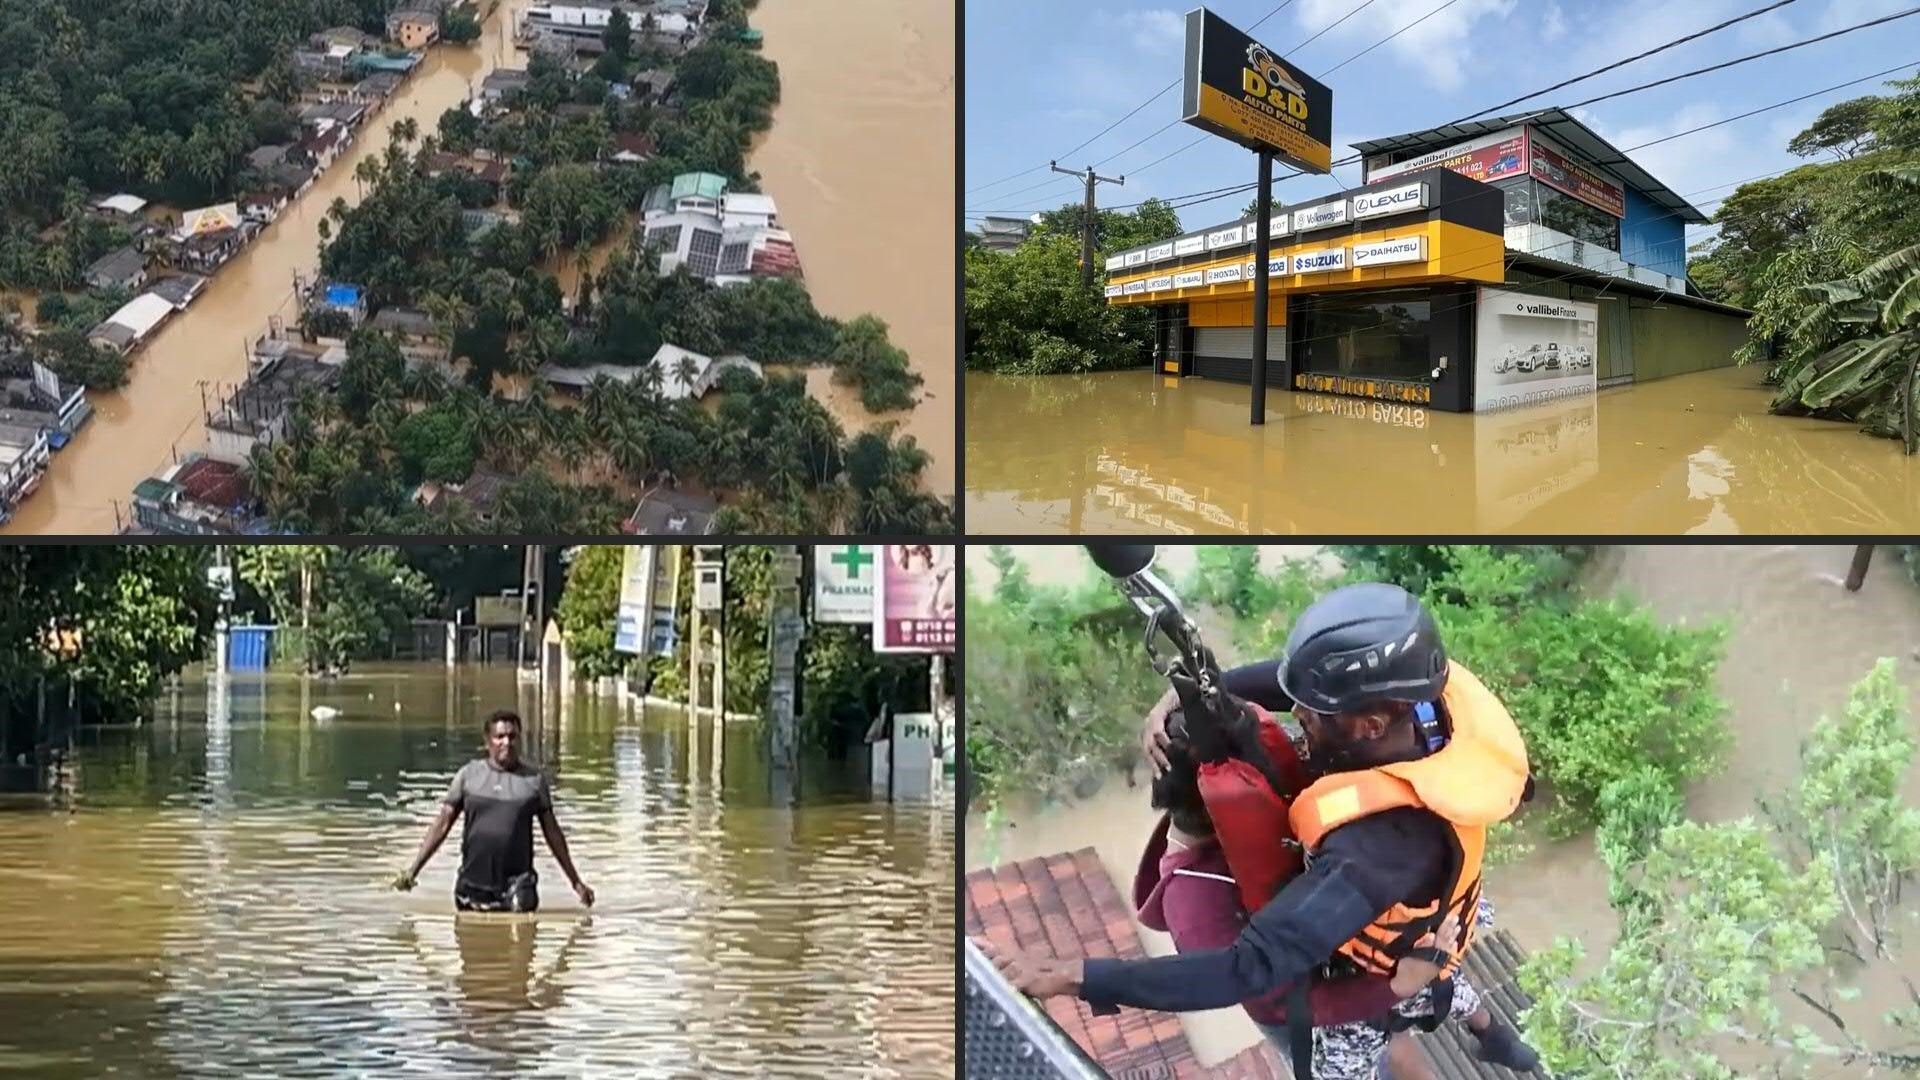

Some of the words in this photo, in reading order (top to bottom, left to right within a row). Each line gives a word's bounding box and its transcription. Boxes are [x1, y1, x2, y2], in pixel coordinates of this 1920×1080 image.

[1243, 67, 1309, 120] D&D
[1243, 94, 1275, 116] AUTO
[1275, 110, 1307, 131] PARTS
[1412, 150, 1448, 167] vallibel
[1444, 154, 1472, 168] PARTS
[1369, 189, 1419, 209] LEXUS
[1306, 209, 1344, 224] Volkswagen
[1222, 231, 1237, 243] MINI
[1370, 243, 1417, 257] DAIHATSU
[1304, 254, 1343, 268] SUZUKI
[1213, 268, 1240, 279] HONDA
[1526, 304, 1559, 316] vallibel
[1331, 376, 1365, 397] AUTO
[1373, 381, 1426, 404] PARTS
